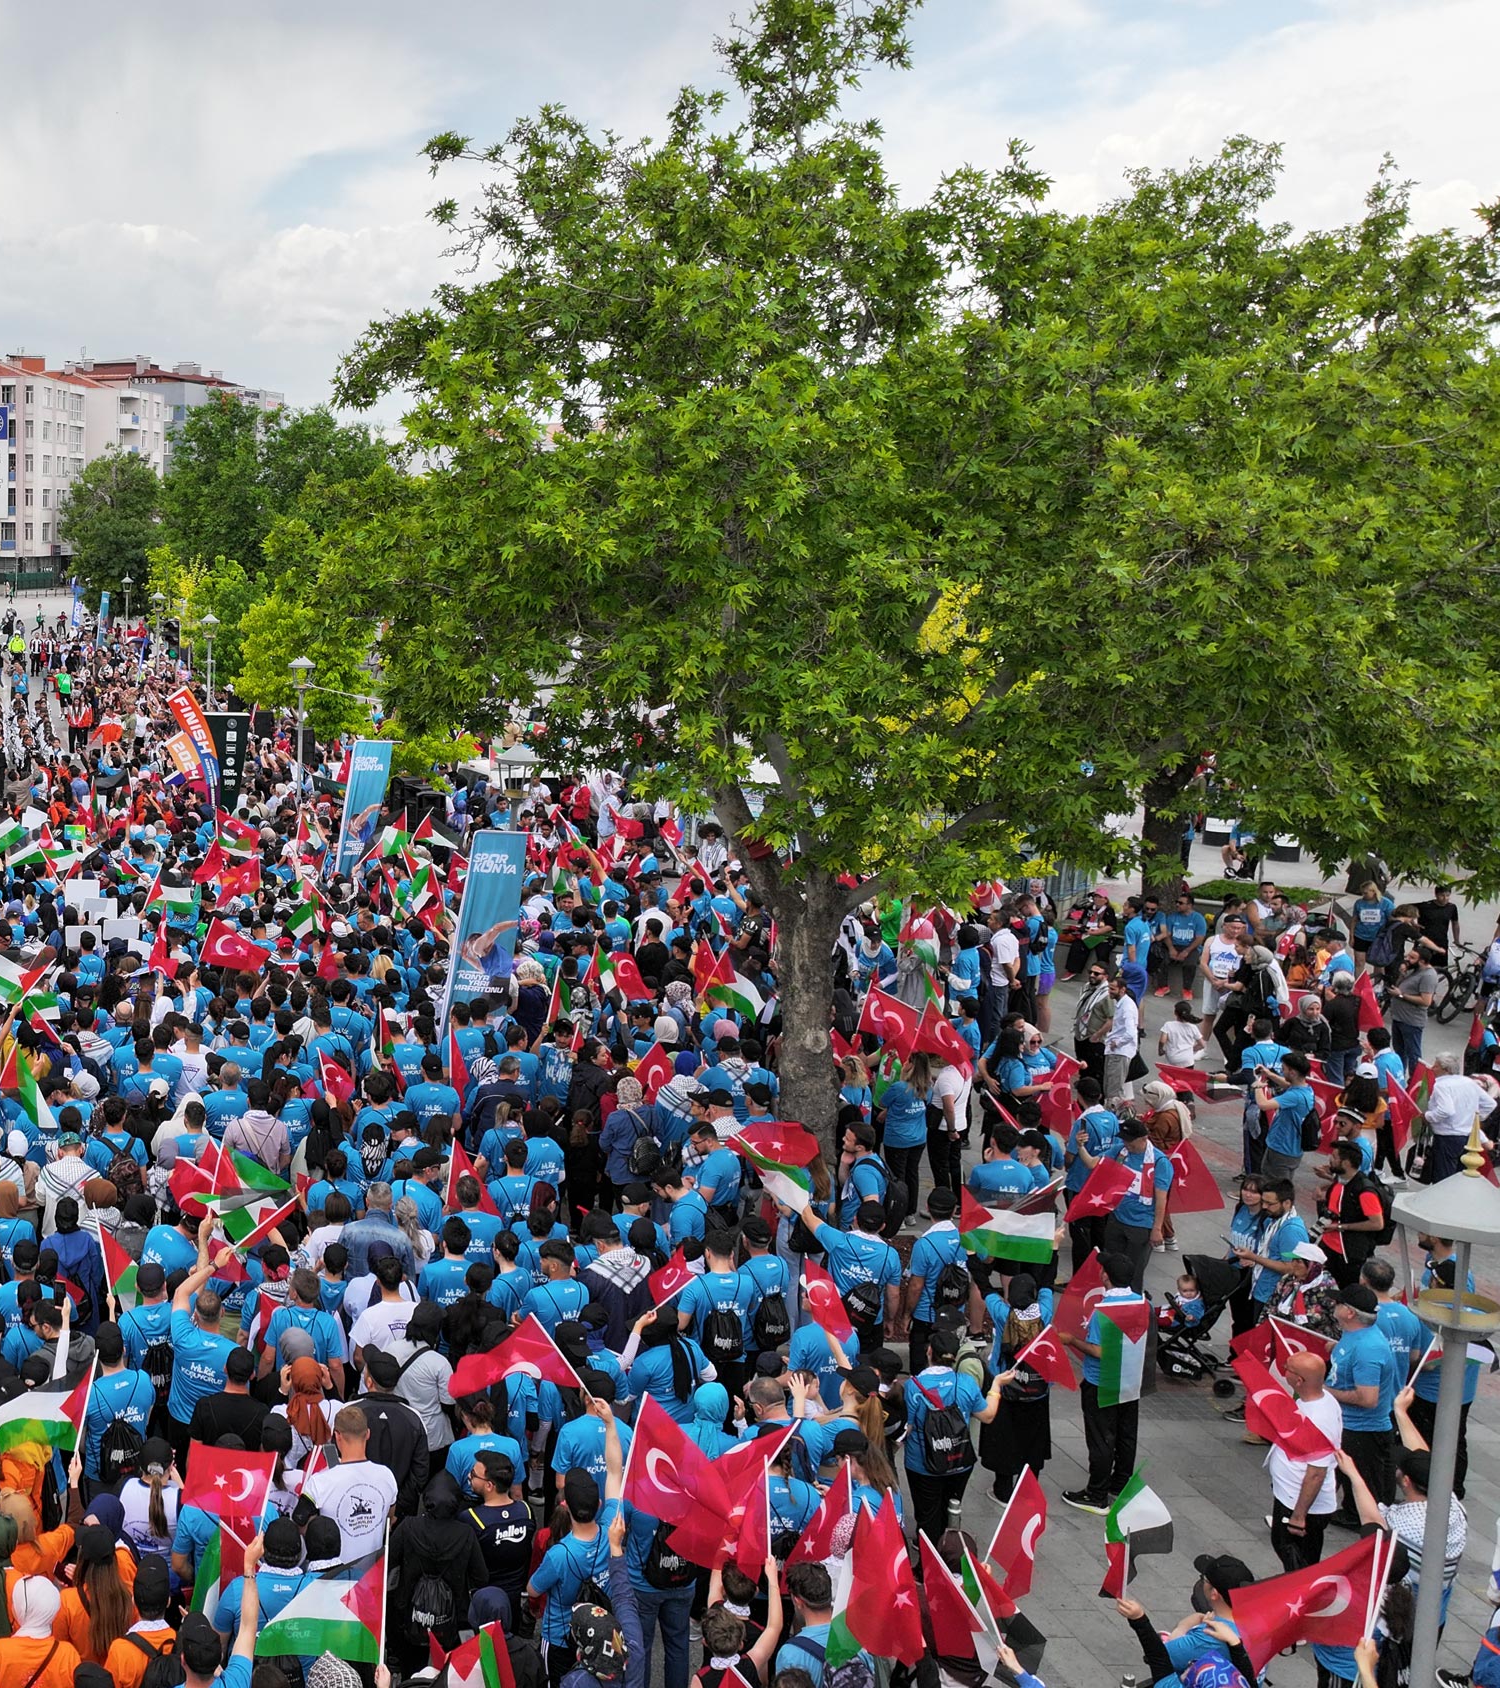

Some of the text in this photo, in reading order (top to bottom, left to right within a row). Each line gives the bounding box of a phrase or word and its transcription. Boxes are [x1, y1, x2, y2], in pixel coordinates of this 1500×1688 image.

[173, 696, 213, 755] FINISH
[172, 741, 201, 780] 2024
[355, 763, 384, 772] KONYA
[473, 853, 509, 864] SPOR
[473, 860, 517, 875] KONYA
[458, 972, 490, 980] KONYA
[453, 984, 504, 993] MARATONU
[389, 1322, 407, 1331] KONY
[495, 1525, 526, 1542] halley
